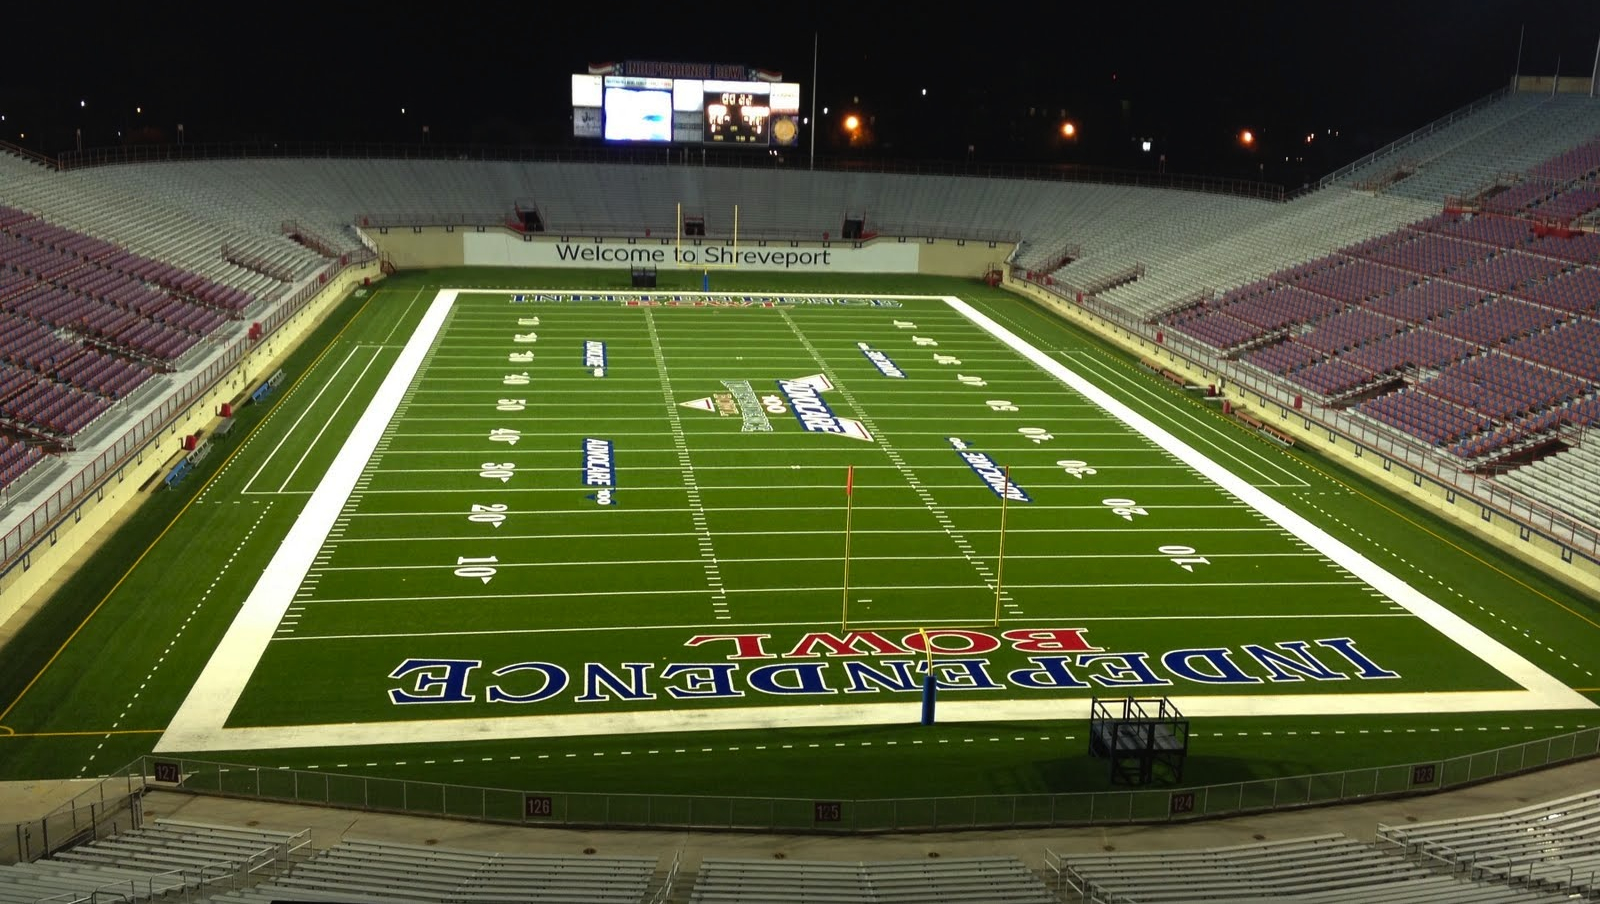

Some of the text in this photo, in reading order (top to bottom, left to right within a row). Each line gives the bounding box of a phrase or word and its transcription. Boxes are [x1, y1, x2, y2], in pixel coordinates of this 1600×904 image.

[556, 244, 831, 268] Welcome to Shreveport
[496, 399, 527, 411] 50
[762, 395, 787, 413] 100
[778, 380, 842, 433] ADVOCARE
[985, 400, 1020, 411] 50
[488, 428, 522, 441] 40
[1017, 427, 1055, 440] 40
[479, 462, 516, 478] 30
[586, 438, 611, 486] ADVOCARE
[1056, 460, 1098, 475] 30
[961, 451, 1029, 502] ADVOCARE
[467, 503, 508, 523] 20
[1102, 498, 1150, 516] 20
[1158, 545, 1212, 565] 10
[453, 555, 499, 577] 10
[684, 627, 1105, 660] BOWL
[388, 637, 1402, 705] INDEPENDENCE
[157, 765, 177, 781] 127
[1415, 767, 1433, 782] 123
[528, 798, 550, 814] 126
[1174, 794, 1192, 811] 124
[817, 804, 839, 820] 125
